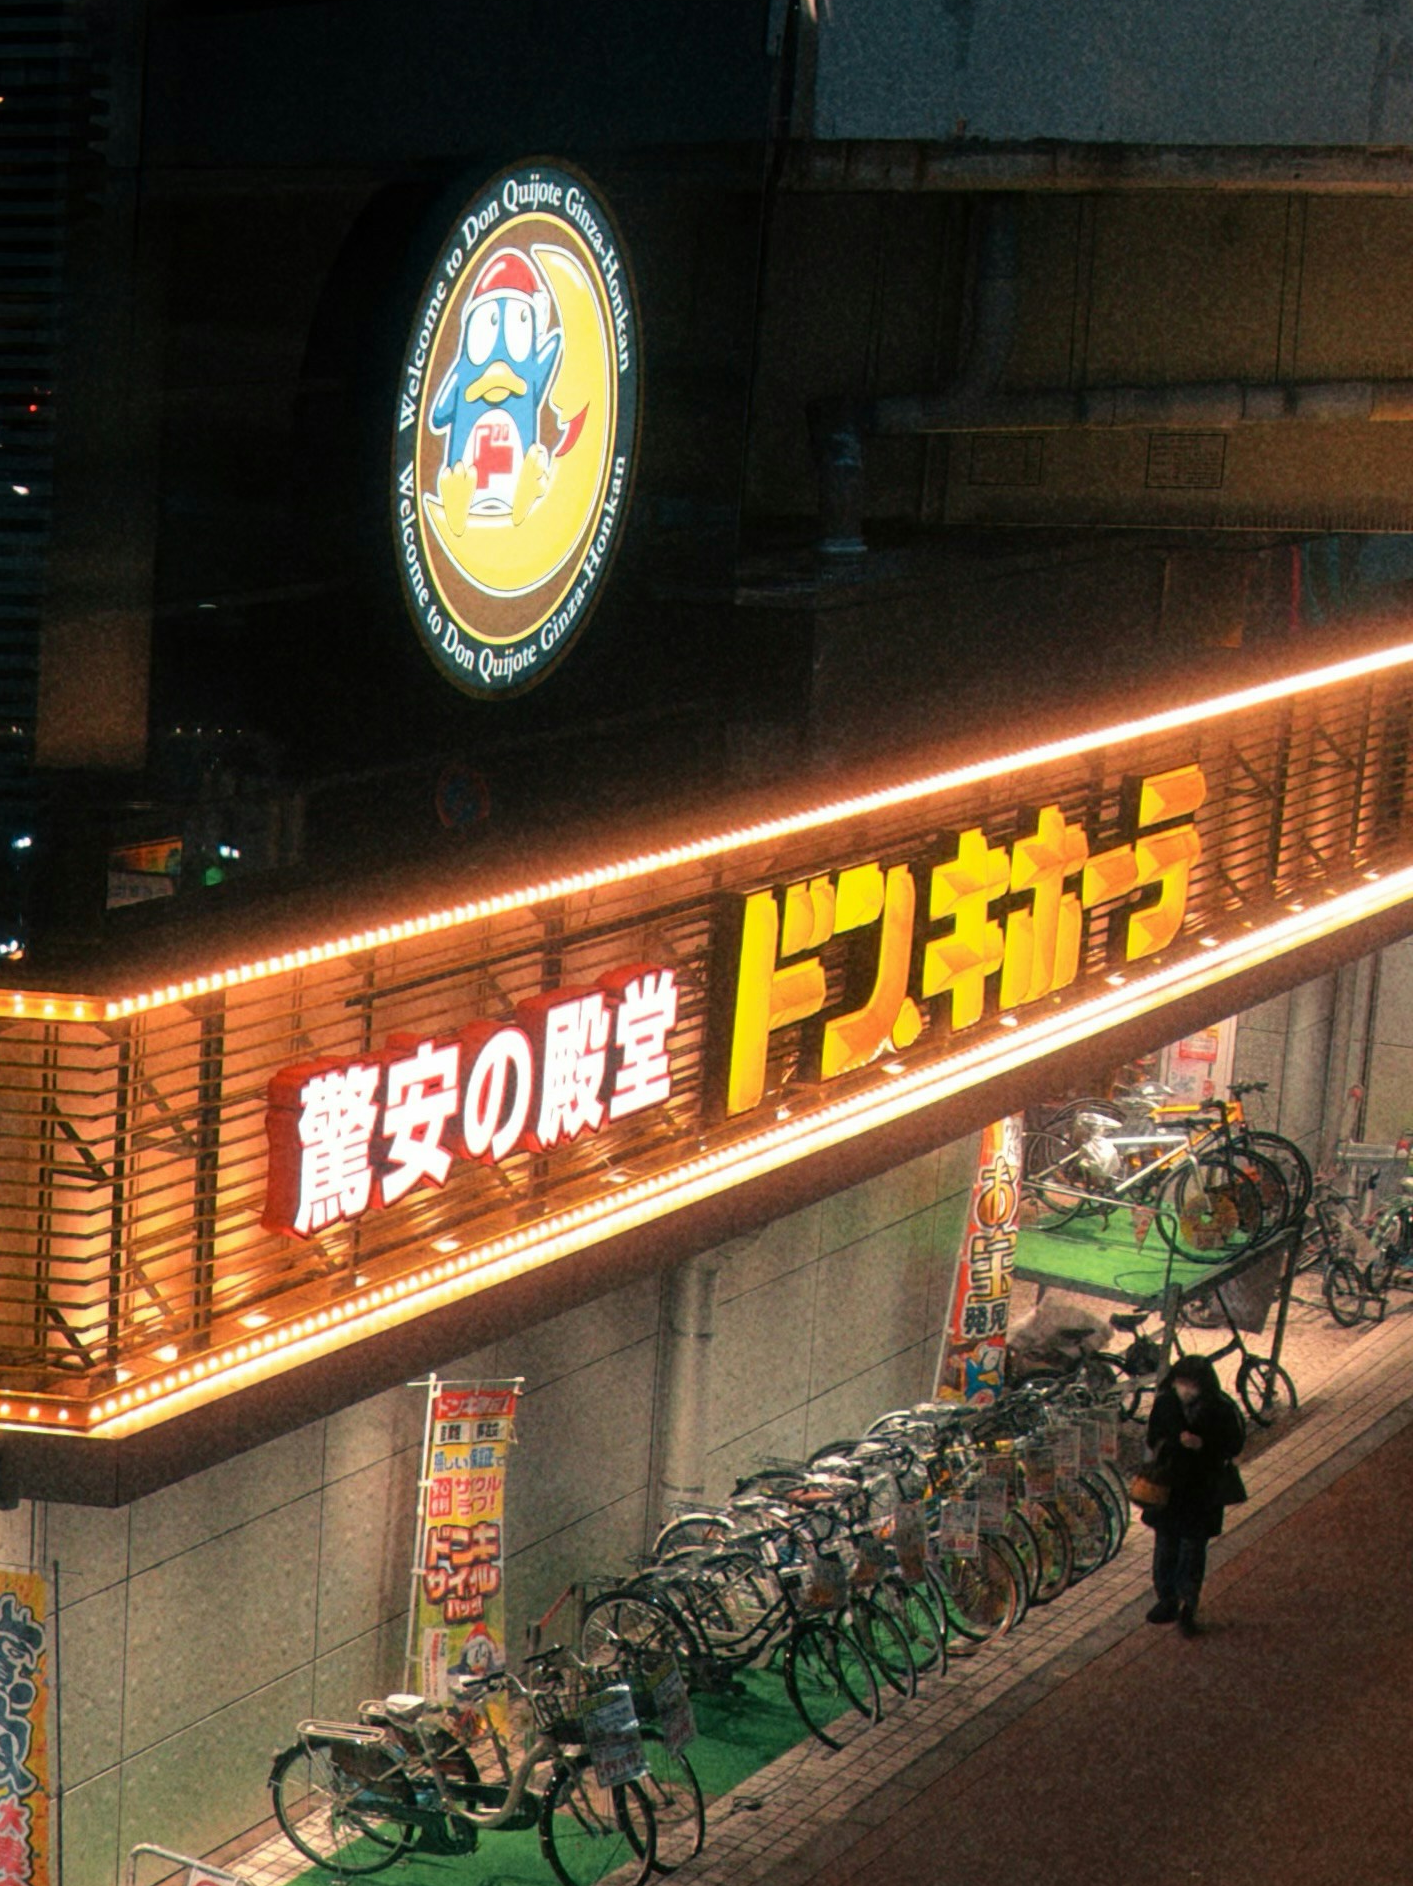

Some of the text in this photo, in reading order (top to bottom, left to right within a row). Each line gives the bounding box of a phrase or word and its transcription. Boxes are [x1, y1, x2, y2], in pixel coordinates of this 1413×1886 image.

[399, 173, 630, 433] Welcome to Don Quijote Ginza-Honkan
[399, 456, 627, 684] Welcome to Don Quijote Ginza-Honkan
[296, 969, 679, 1236] 驚安の殿堂
